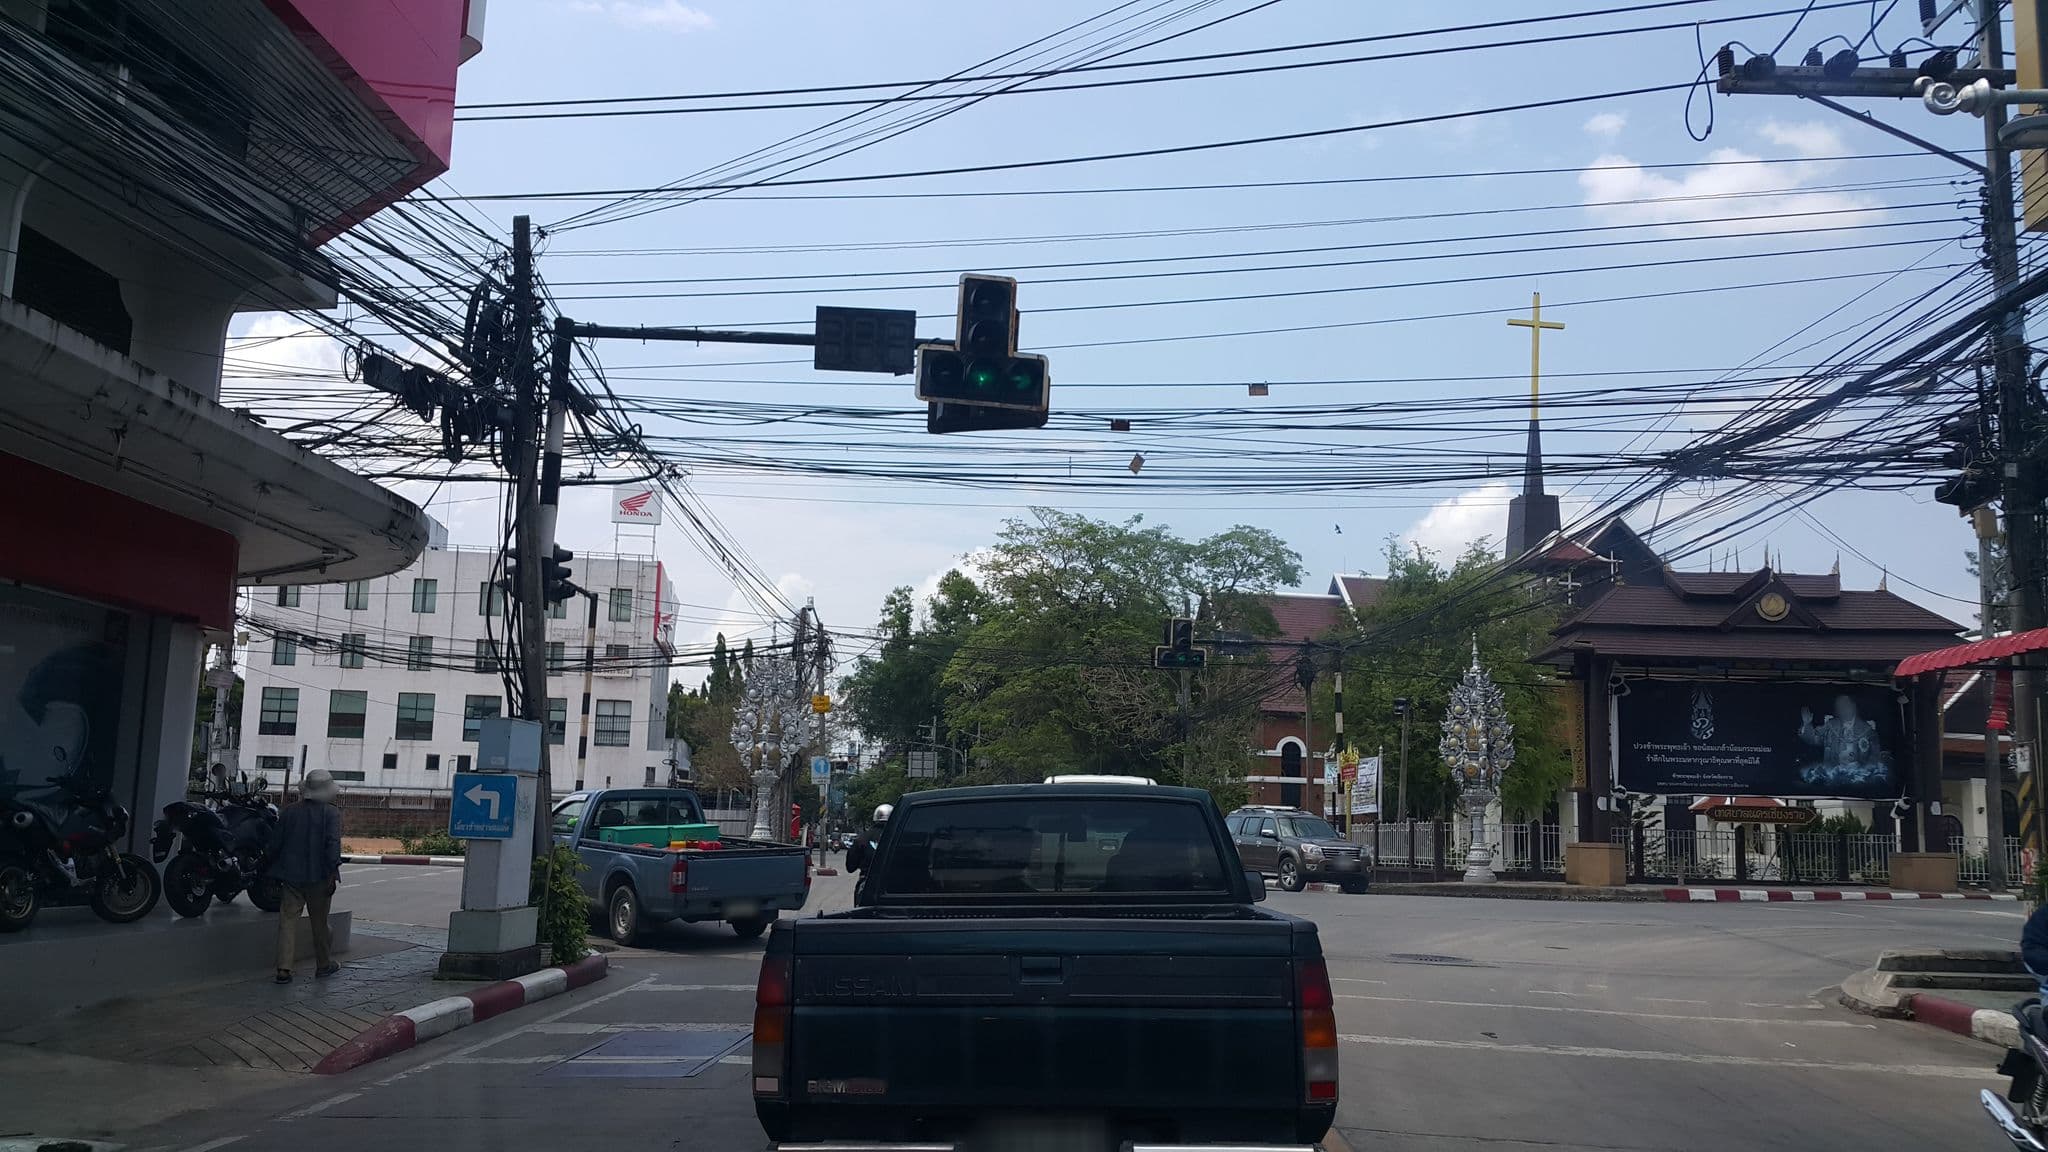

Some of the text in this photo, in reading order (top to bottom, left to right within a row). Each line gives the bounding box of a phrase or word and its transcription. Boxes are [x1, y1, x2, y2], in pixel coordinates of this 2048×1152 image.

[619, 510, 653, 518] HONDA
[1713, 807, 1805, 820] เทศบาลนครเชียงราย
[803, 976, 917, 998] NISSAN
